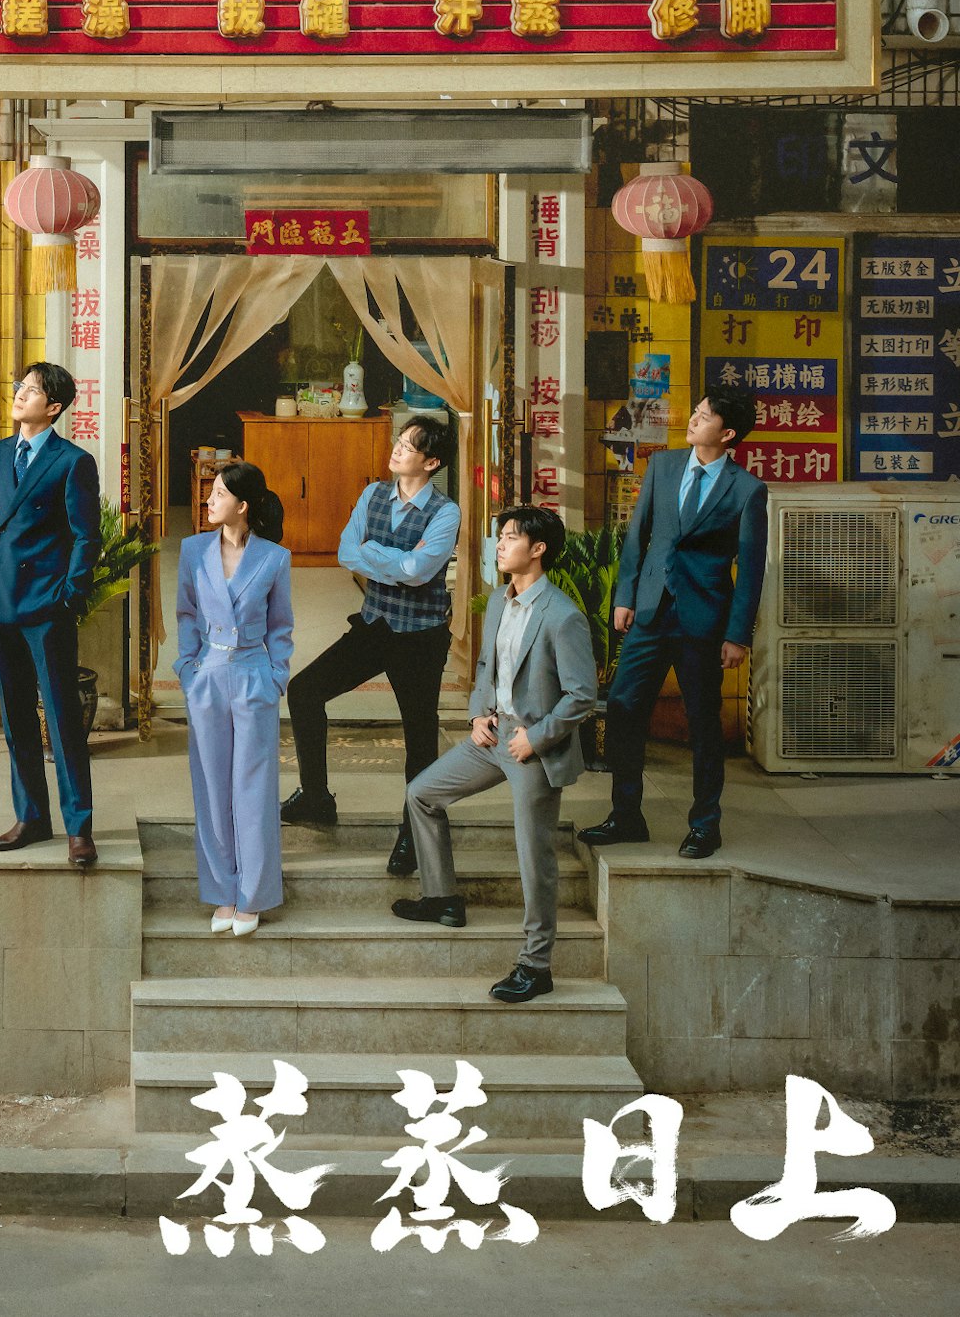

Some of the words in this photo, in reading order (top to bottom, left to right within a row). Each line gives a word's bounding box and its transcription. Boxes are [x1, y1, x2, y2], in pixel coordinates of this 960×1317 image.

[530, 195, 560, 258] 捶背
[767, 249, 831, 290] 24
[865, 260, 930, 277] 无版烫金
[71, 288, 100, 350] 拔罐
[530, 285, 560, 348] 刮痧
[865, 299, 931, 316] 无版切割
[721, 313, 822, 347] 打印
[865, 338, 930, 354] 大图打印
[719, 361, 826, 390] 条幅横幅
[865, 377, 930, 393] 异形贴纸
[71, 378, 100, 440] 汗蒸
[530, 376, 560, 438] 按摩
[865, 415, 929, 432] 异形卡片
[873, 454, 921, 471] 包装盒
